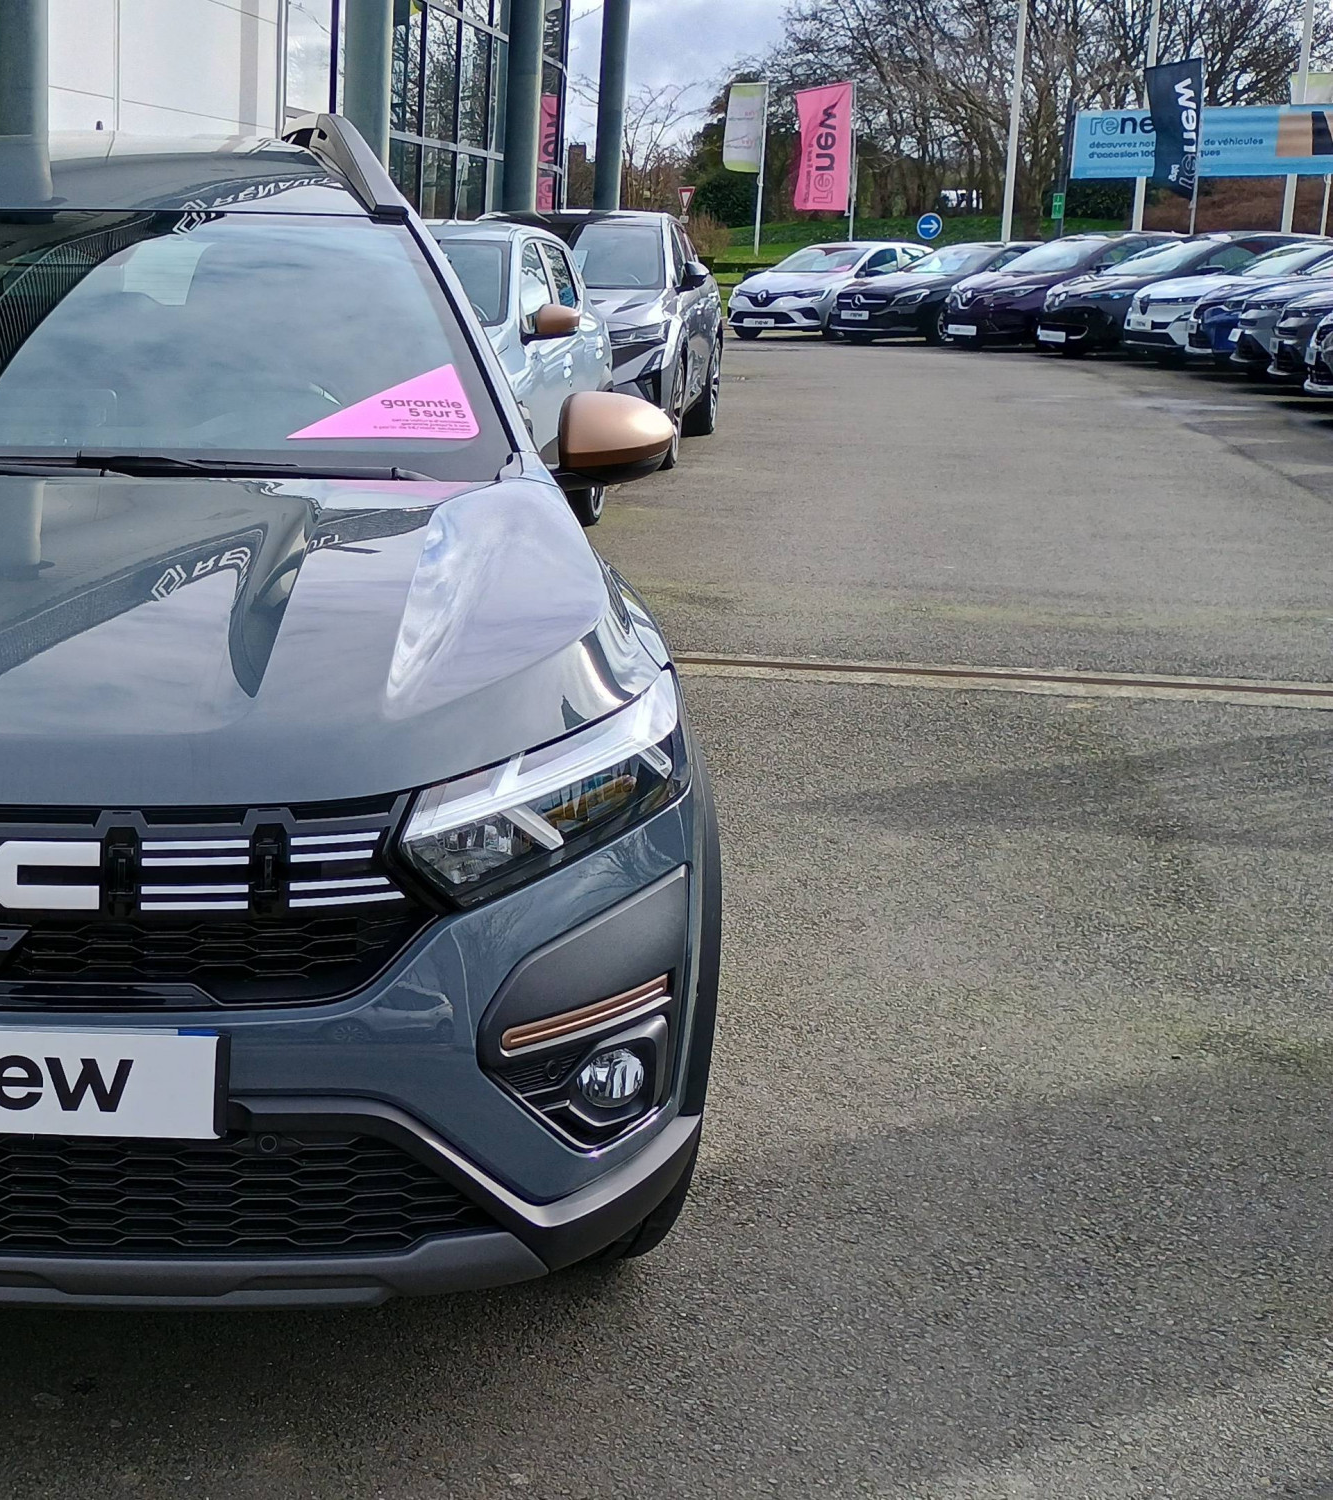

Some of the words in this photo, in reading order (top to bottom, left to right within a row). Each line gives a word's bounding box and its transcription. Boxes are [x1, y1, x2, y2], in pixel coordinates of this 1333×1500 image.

[1090, 116, 1156, 135] rene
[1089, 141, 1137, 149] découvrez
[1218, 137, 1264, 145] véhicules
[381, 399, 462, 409] garantie
[409, 408, 420, 417] 5
[423, 409, 452, 418] sur
[455, 410, 466, 419] 5
